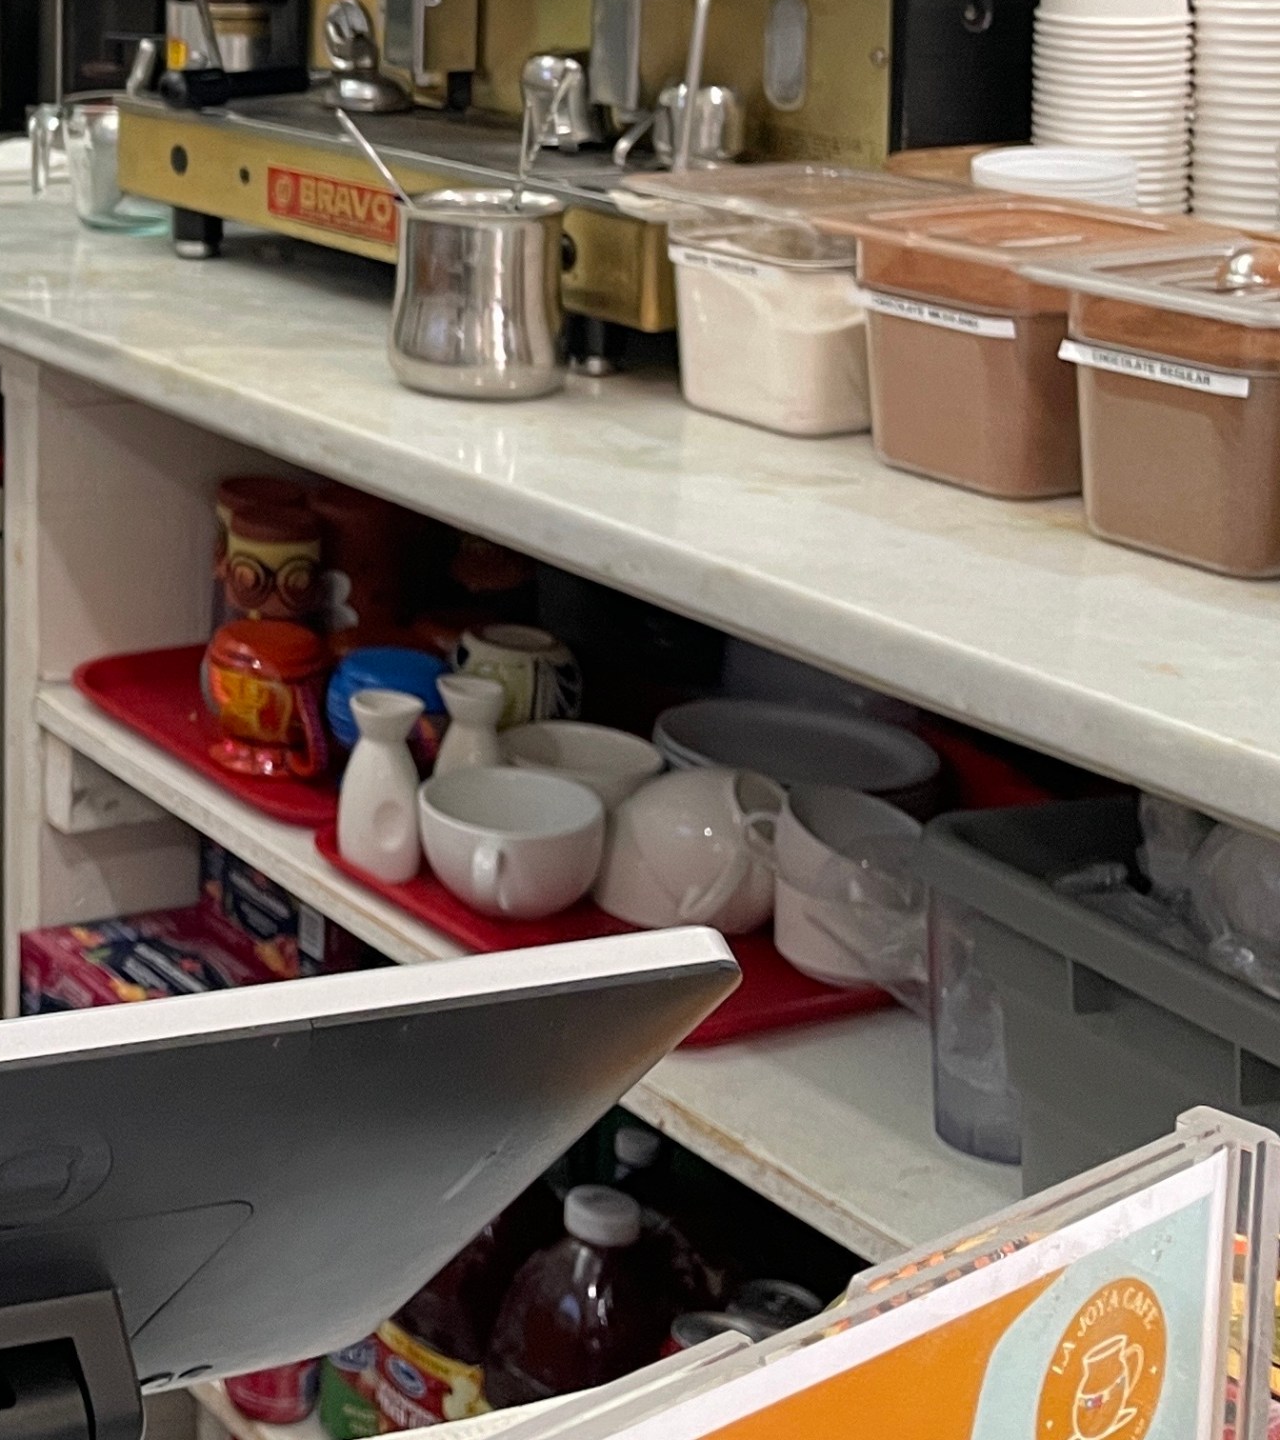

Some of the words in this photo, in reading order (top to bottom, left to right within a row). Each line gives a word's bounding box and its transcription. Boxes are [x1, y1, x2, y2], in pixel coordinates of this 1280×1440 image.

[299, 176, 393, 226] BRAVO
[1051, 1341, 1076, 1375] LA
[1077, 1289, 1119, 1337] JOYA
